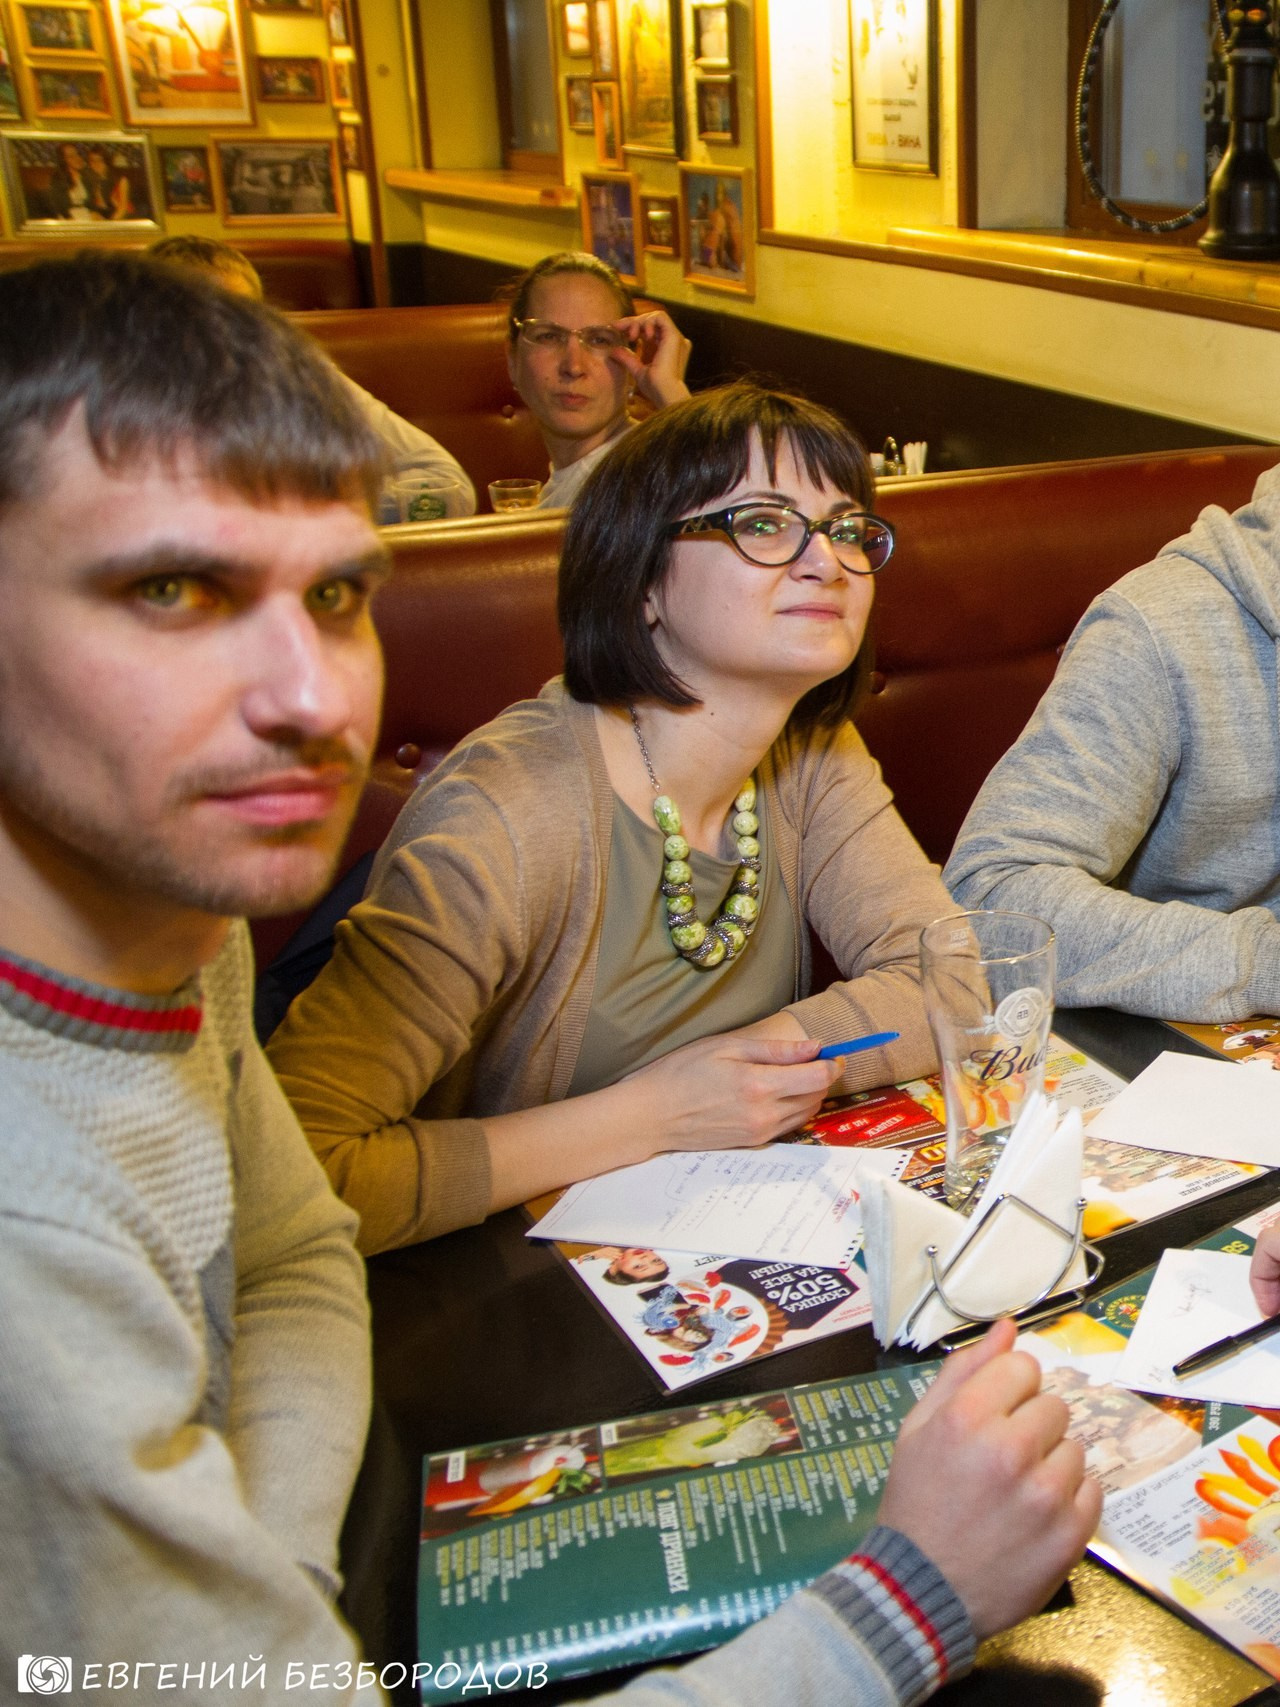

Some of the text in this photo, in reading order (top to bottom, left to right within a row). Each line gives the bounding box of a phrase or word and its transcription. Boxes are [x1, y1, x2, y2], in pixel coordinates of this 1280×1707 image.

[862, 1113, 905, 1137] ПОДАРОК
[759, 1270, 790, 1288] ВСЕ
[766, 1272, 841, 1307] 50%
[1208, 1416, 1219, 1430] 390
[658, 1529, 691, 1594] ДРИНКИ
